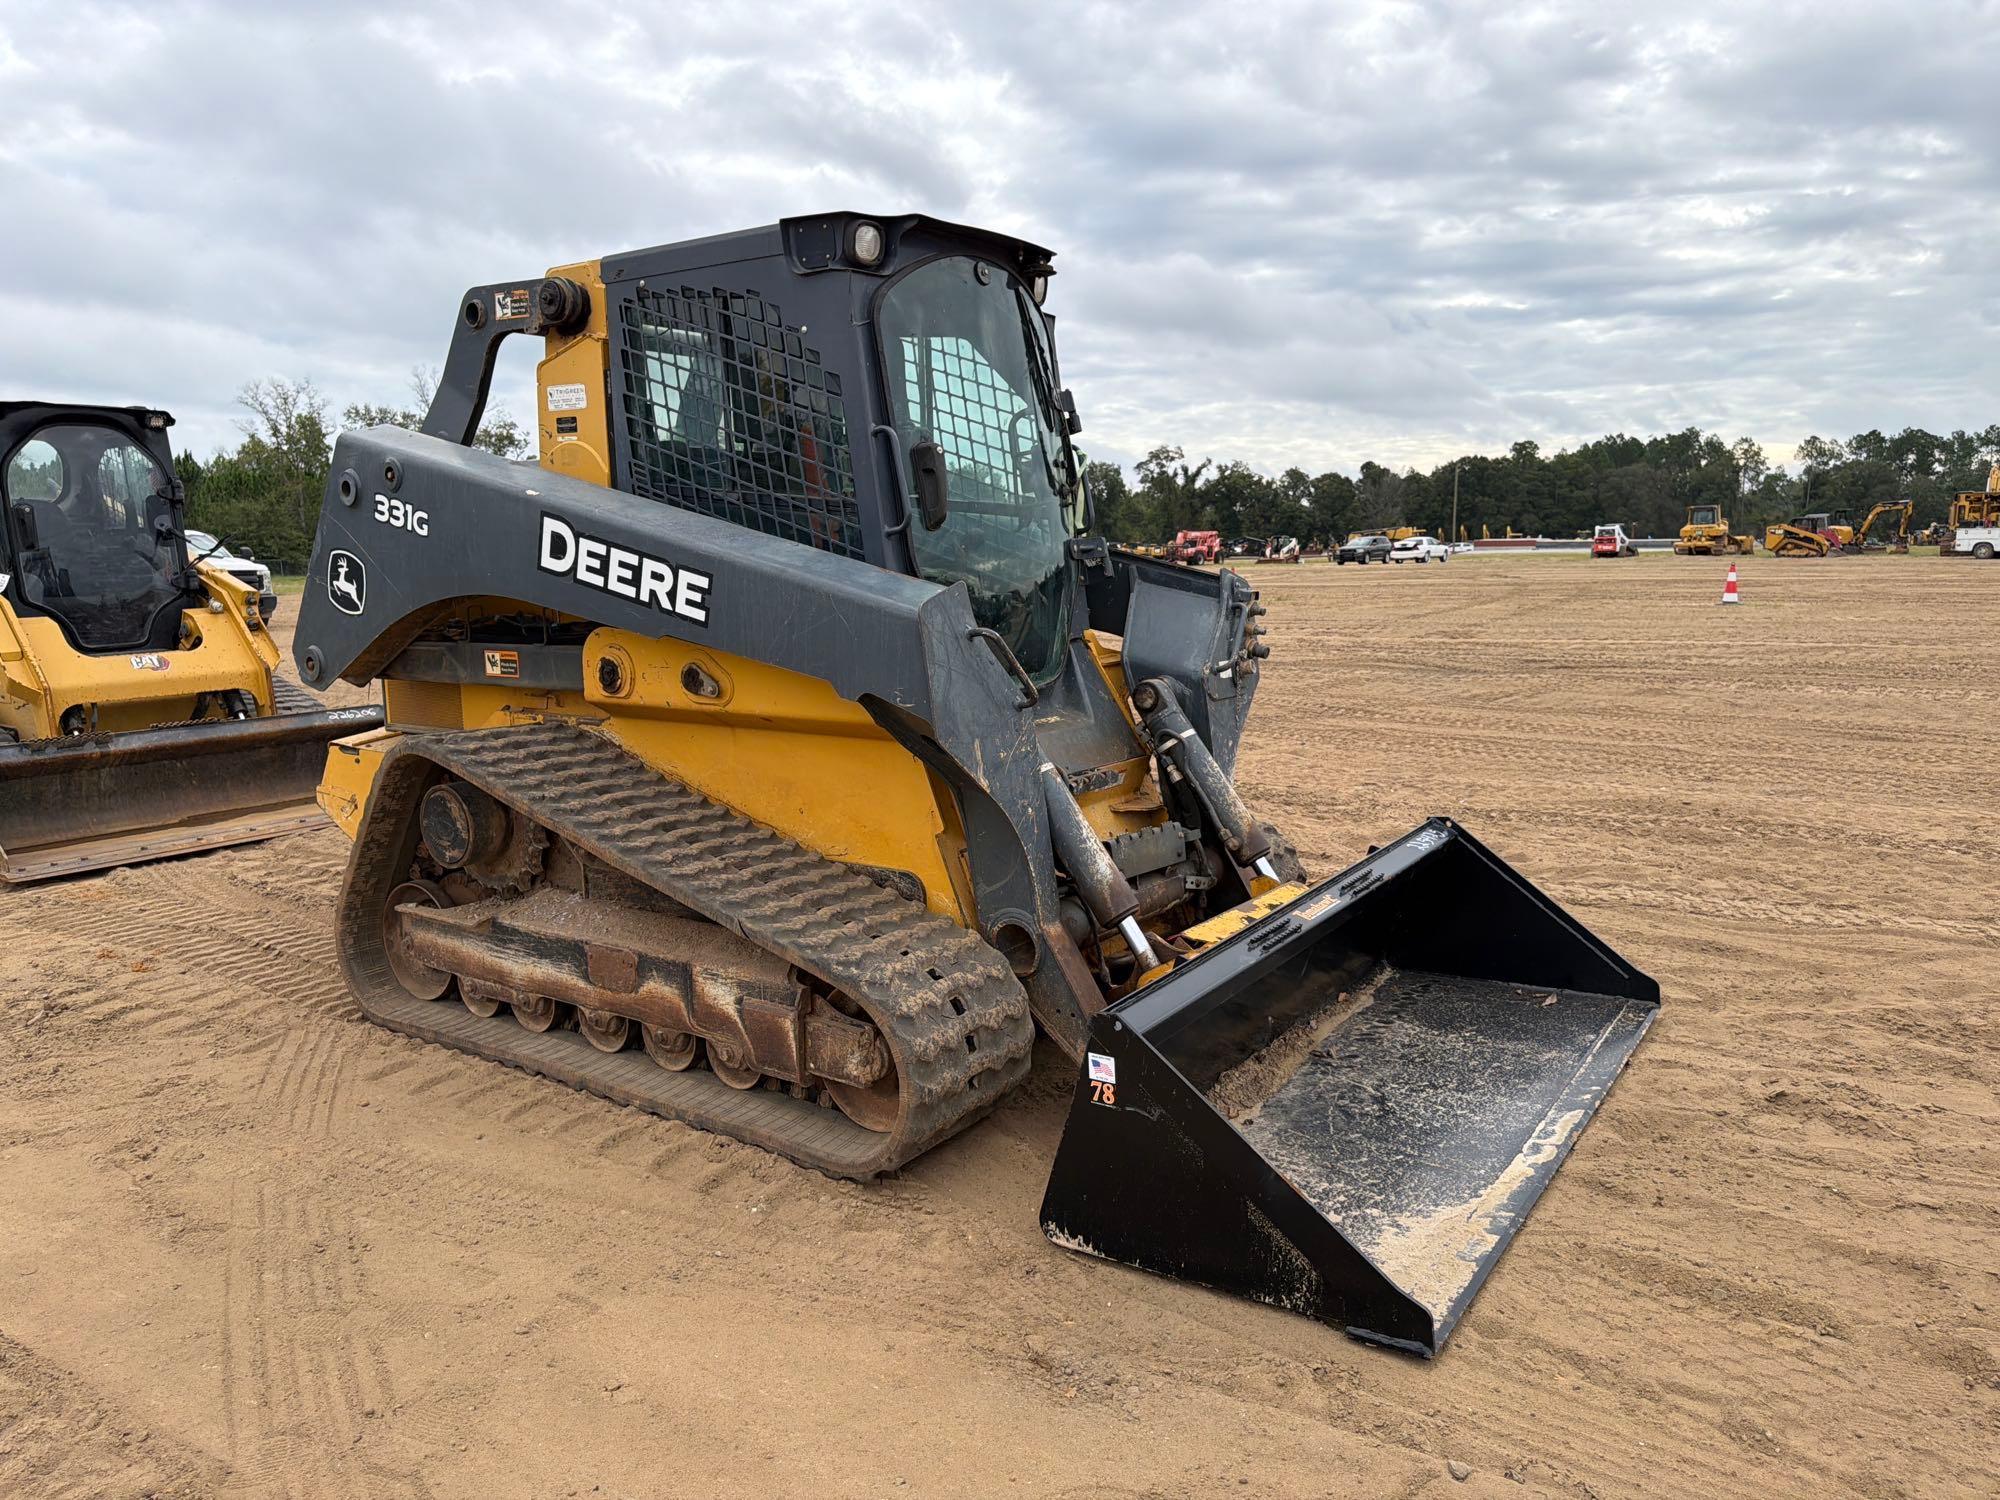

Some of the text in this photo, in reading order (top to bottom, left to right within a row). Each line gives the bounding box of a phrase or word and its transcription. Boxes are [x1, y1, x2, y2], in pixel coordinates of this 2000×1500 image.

[374, 494, 429, 536] 331G
[541, 516, 709, 622] DEERE
[130, 655, 161, 669] CAT
[326, 708, 377, 720] 226206
[1091, 1081, 1115, 1104] 78
